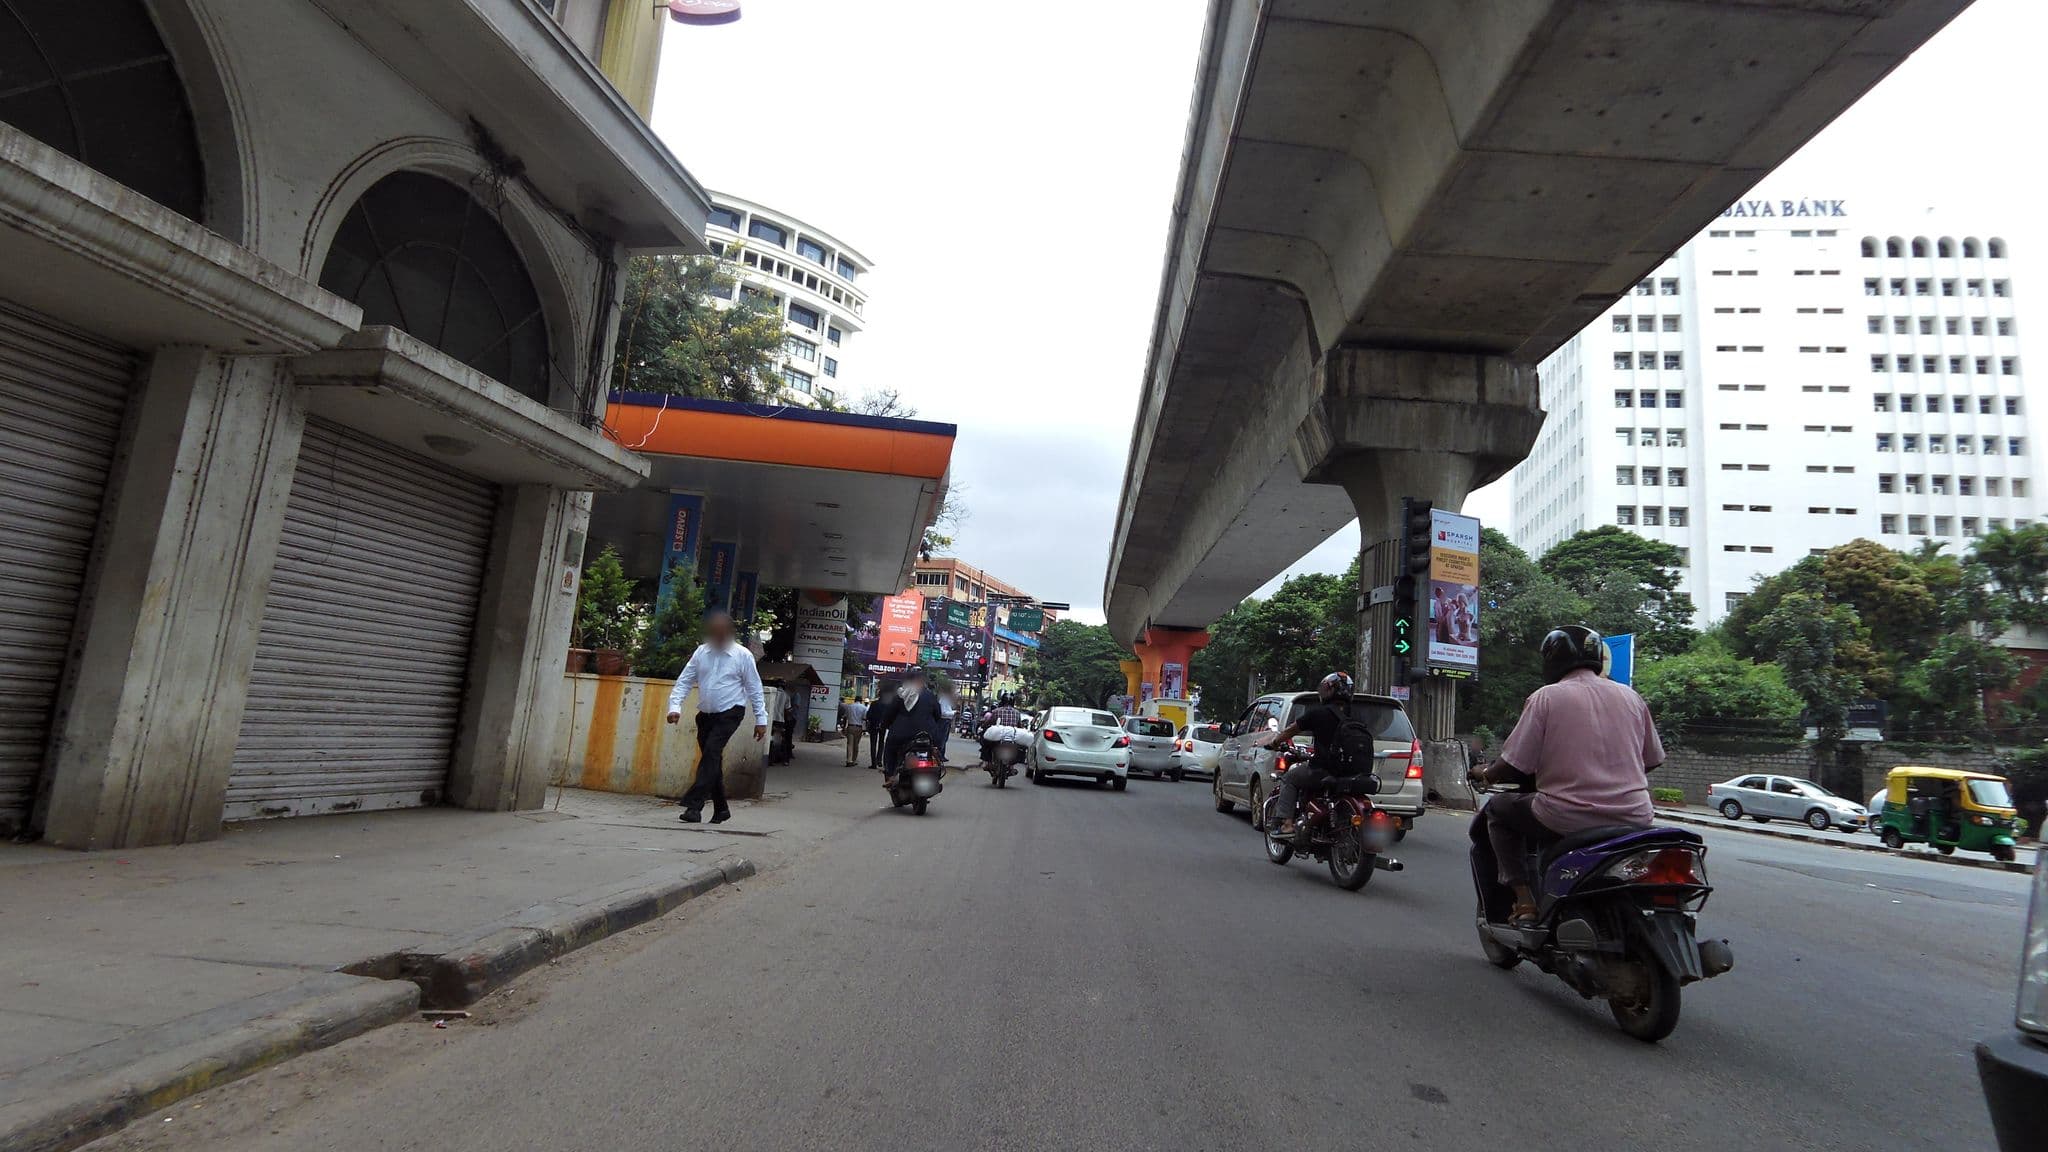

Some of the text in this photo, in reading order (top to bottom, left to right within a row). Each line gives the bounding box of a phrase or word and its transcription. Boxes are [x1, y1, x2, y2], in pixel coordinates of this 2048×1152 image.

[1781, 200, 1847, 217] BANK
[675, 510, 687, 541] SERVO
[1446, 531, 1474, 541] SPARSH
[799, 607, 846, 619] IndianOil
[807, 647, 830, 655] PETROL
